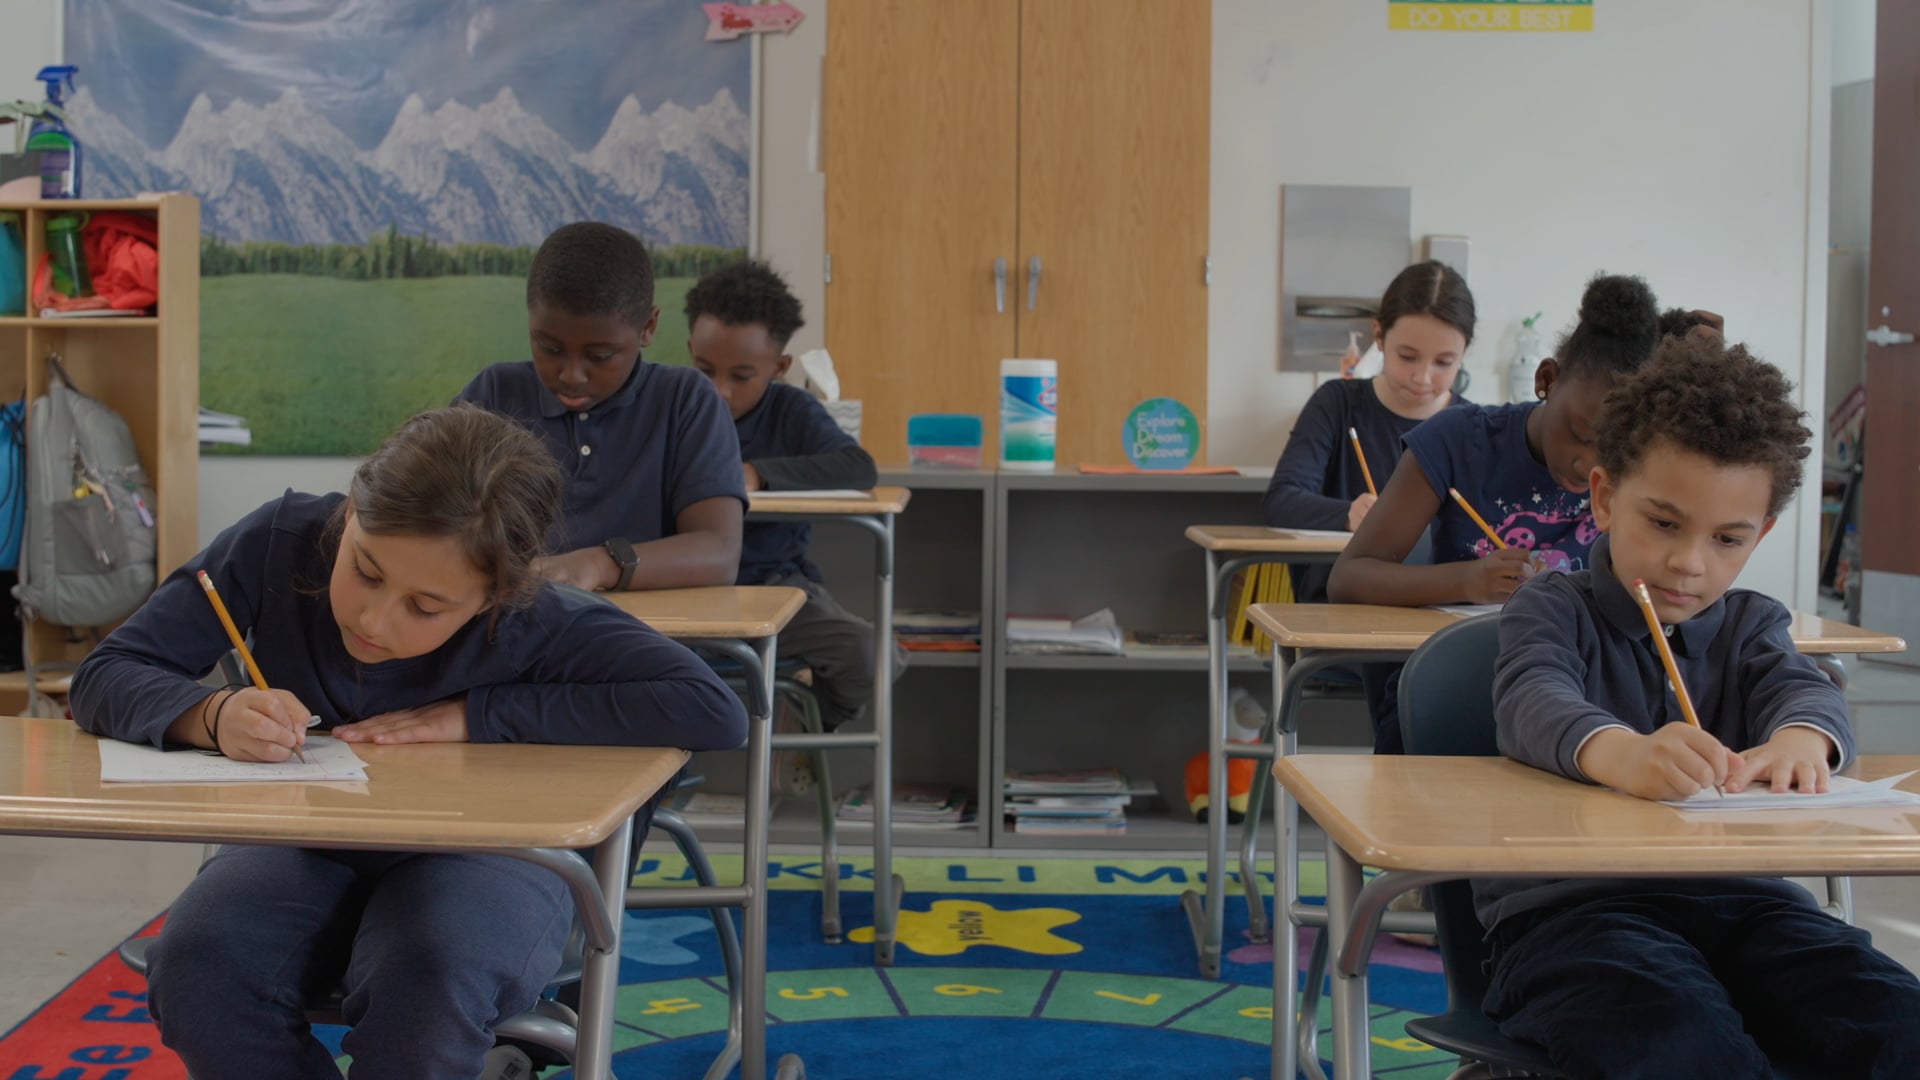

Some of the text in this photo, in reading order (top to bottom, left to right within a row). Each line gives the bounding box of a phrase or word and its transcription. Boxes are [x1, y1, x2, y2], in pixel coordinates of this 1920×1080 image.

[1409, 8, 1573, 29] DO YOUR BEST
[1138, 411, 1186, 434] Explore
[1138, 429, 1183, 444] Dream
[1133, 442, 1189, 459] Discover
[948, 910, 993, 941] yellow
[778, 986, 850, 1000] 5
